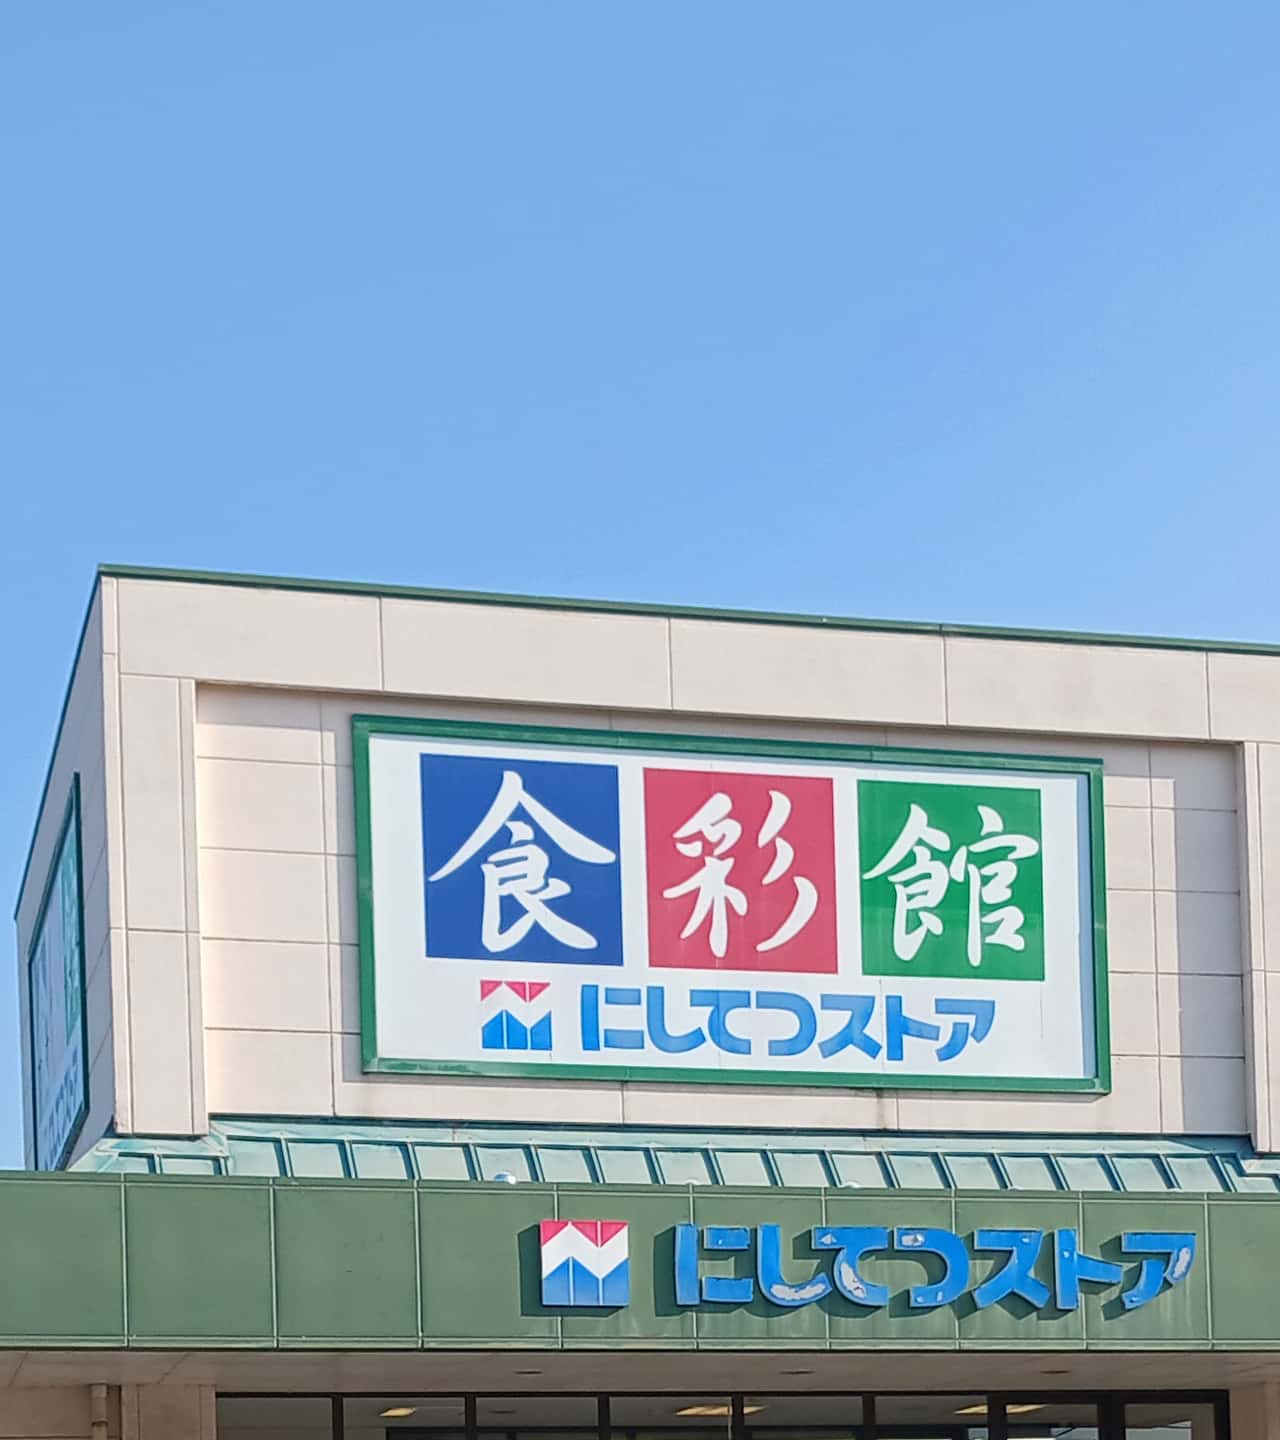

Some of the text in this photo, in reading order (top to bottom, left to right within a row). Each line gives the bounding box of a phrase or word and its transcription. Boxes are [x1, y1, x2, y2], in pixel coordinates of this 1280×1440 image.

[428, 770, 1040, 968] 食彩館
[580, 984, 996, 1062] にしてつストア
[674, 1222, 1197, 1310] にしてつストア
